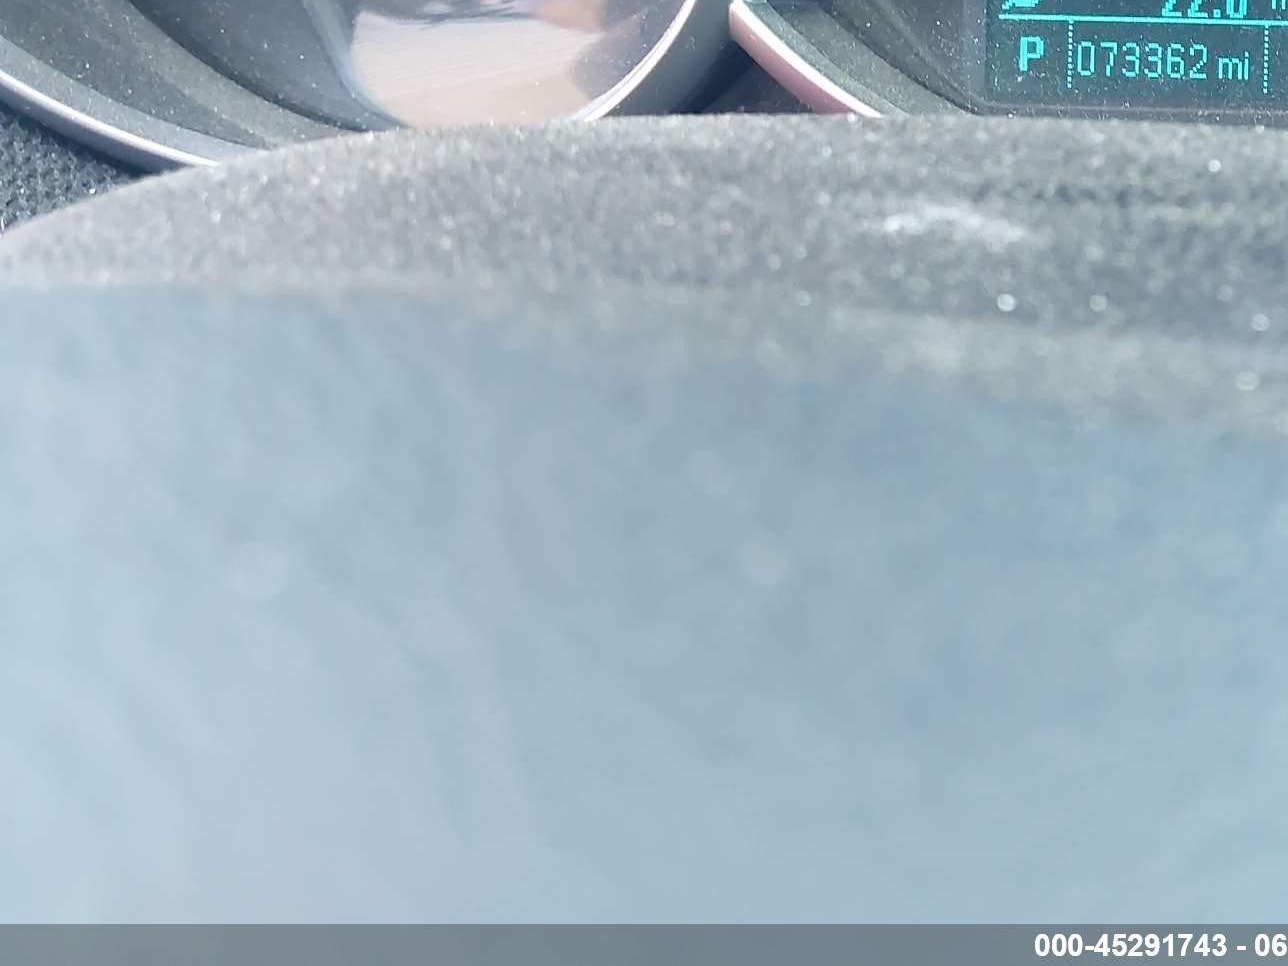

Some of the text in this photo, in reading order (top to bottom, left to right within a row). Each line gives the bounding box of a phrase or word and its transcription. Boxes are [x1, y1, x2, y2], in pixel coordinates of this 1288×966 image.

[1018, 36, 1044, 71] P
[1077, 41, 1250, 81] 073362 mi
